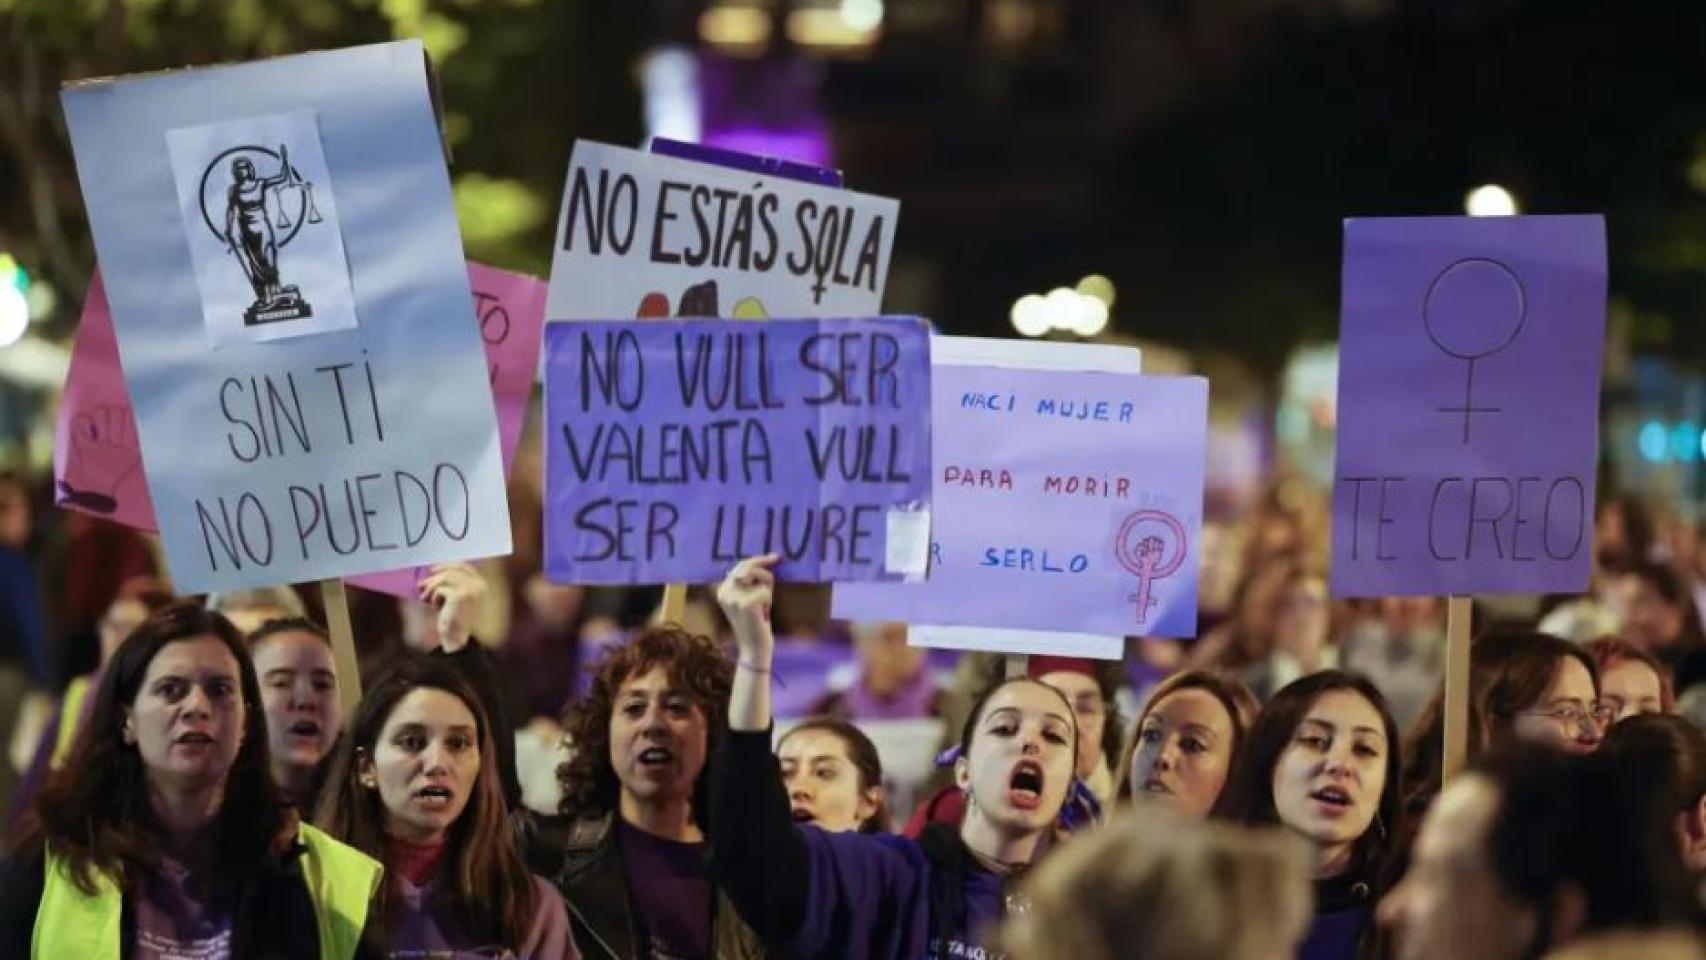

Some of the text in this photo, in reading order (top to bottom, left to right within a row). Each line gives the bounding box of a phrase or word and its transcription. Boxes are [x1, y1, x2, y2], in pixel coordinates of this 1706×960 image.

[563, 167, 883, 304] NO ESTÁS SOLA
[580, 329, 900, 412] NO VULL SER
[219, 372, 311, 463] SIN
[1037, 398, 1133, 424] MUJER
[562, 419, 910, 484] VALENTA VULL
[944, 466, 1014, 491] PARA
[194, 462, 470, 571] NO PUEDO
[574, 497, 881, 564] SER LLIURE
[1340, 476, 1585, 561] TE CREO
[979, 547, 1088, 574] SERLO
